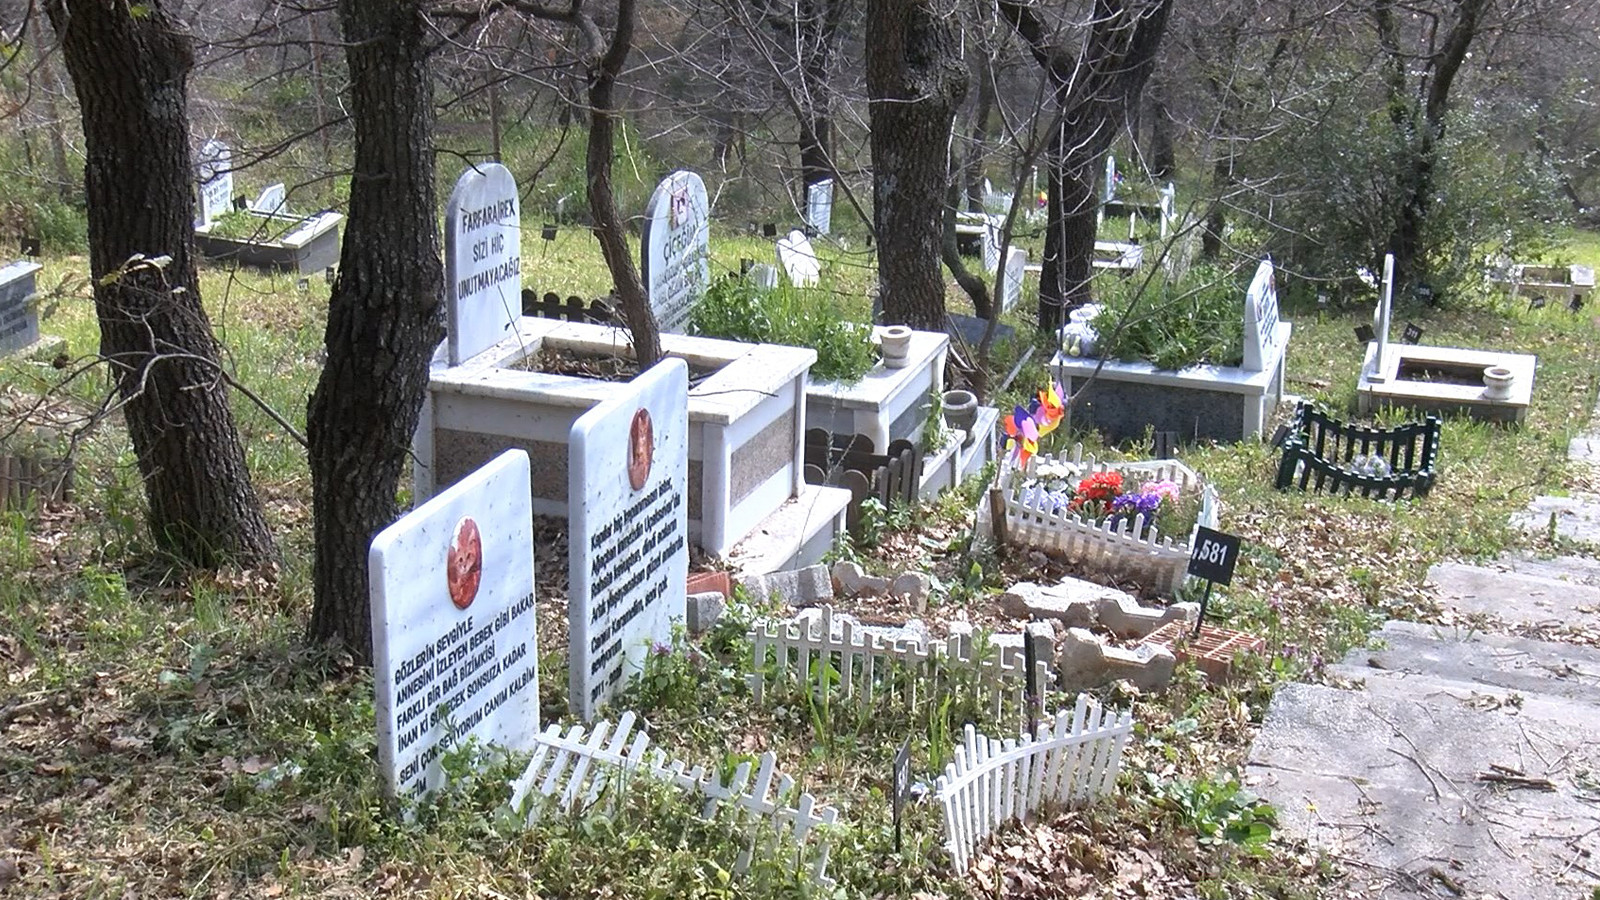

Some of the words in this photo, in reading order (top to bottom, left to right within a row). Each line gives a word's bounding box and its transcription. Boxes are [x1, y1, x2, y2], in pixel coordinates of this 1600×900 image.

[458, 256, 520, 300] UNUTMAYACAĞIZ
[473, 237, 488, 263] SİZİ
[491, 232, 505, 255] HİÇ
[645, 583, 657, 607] seni
[657, 574, 669, 599] çok
[394, 643, 435, 685] GÖZLERİN
[436, 615, 474, 654] SEVGİYLE
[396, 664, 435, 708] ANNESİNİ
[436, 641, 468, 677] İZLEYEN
[469, 621, 493, 652] BEBEK
[494, 605, 510, 632] GİBİ
[511, 592, 535, 621] BAKAR
[396, 698, 426, 731] FARKLI
[427, 684, 441, 707] BİR
[443, 668, 458, 697] BAĞ
[460, 639, 496, 681] BİZİMKİSİ
[398, 727, 418, 753] İNAN
[420, 713, 429, 737] Kİ
[430, 689, 466, 728] SÜECEK
[466, 663, 502, 699] SONSUZA
[503, 642, 527, 669] KADAR
[400, 755, 419, 785] SENİ
[420, 743, 440, 771] ÇOK
[484, 690, 508, 718] CANIM
[509, 665, 535, 700] KALBİM
